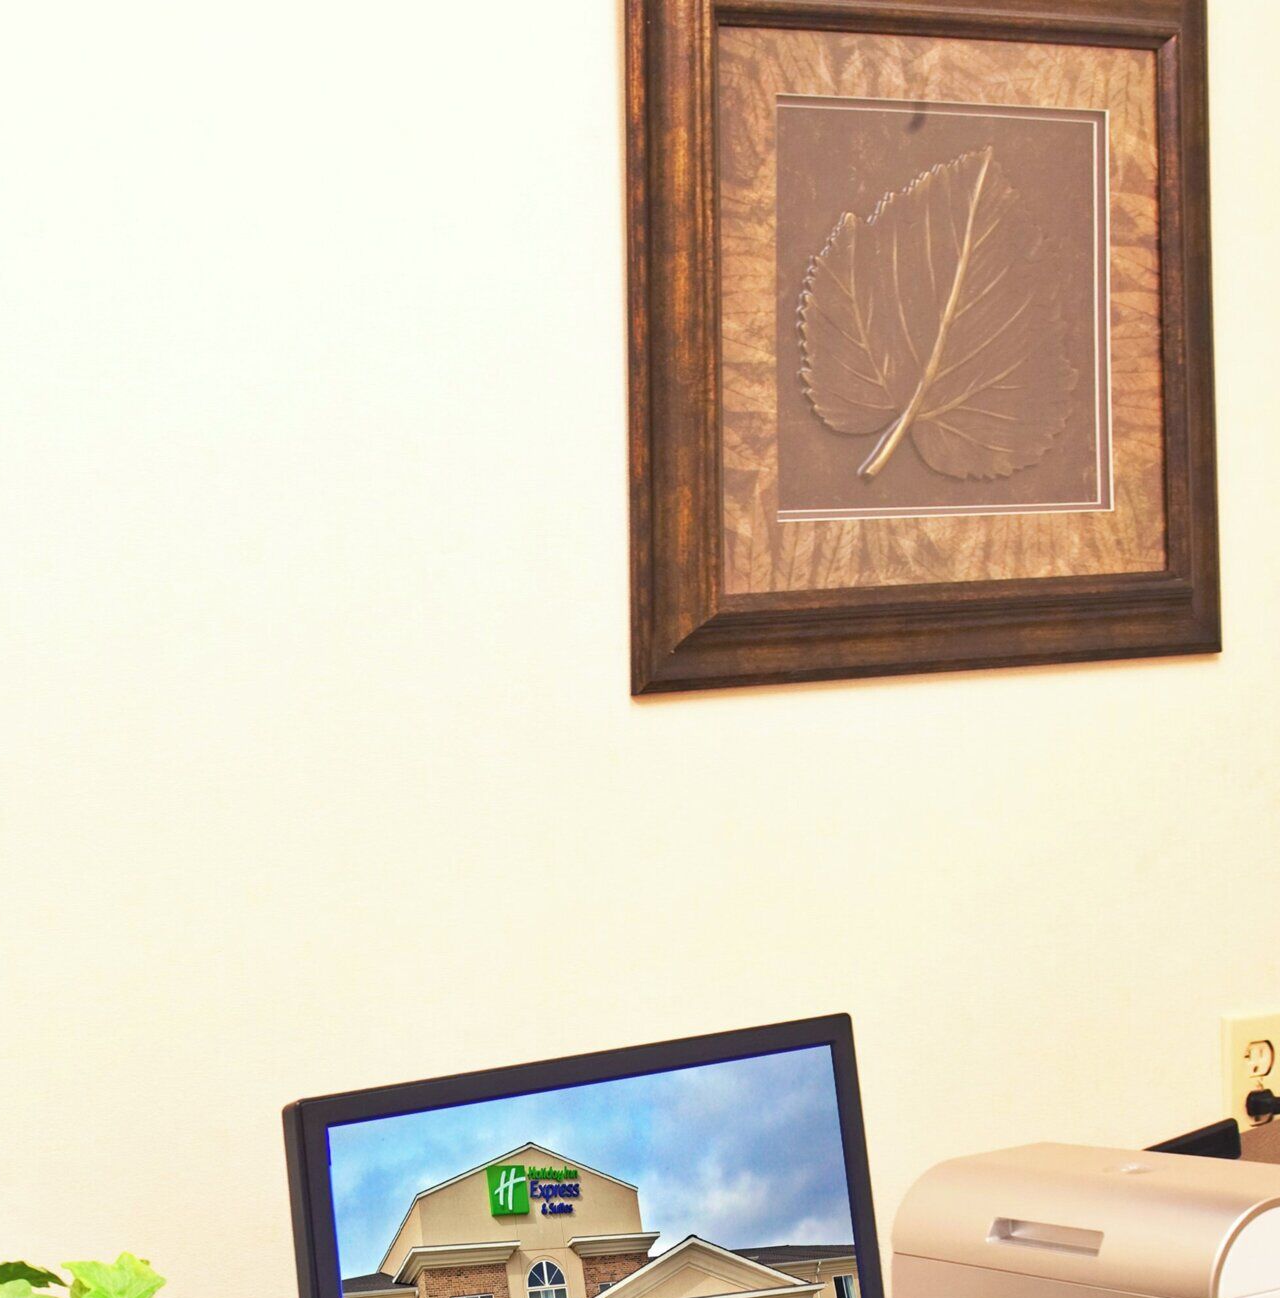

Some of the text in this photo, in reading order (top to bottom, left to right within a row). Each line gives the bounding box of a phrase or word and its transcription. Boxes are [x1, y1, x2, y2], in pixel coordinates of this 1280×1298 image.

[527, 1166, 578, 1182] Holiday Inn
[530, 1180, 580, 1202] Express
[549, 1202, 573, 1214] Suites
